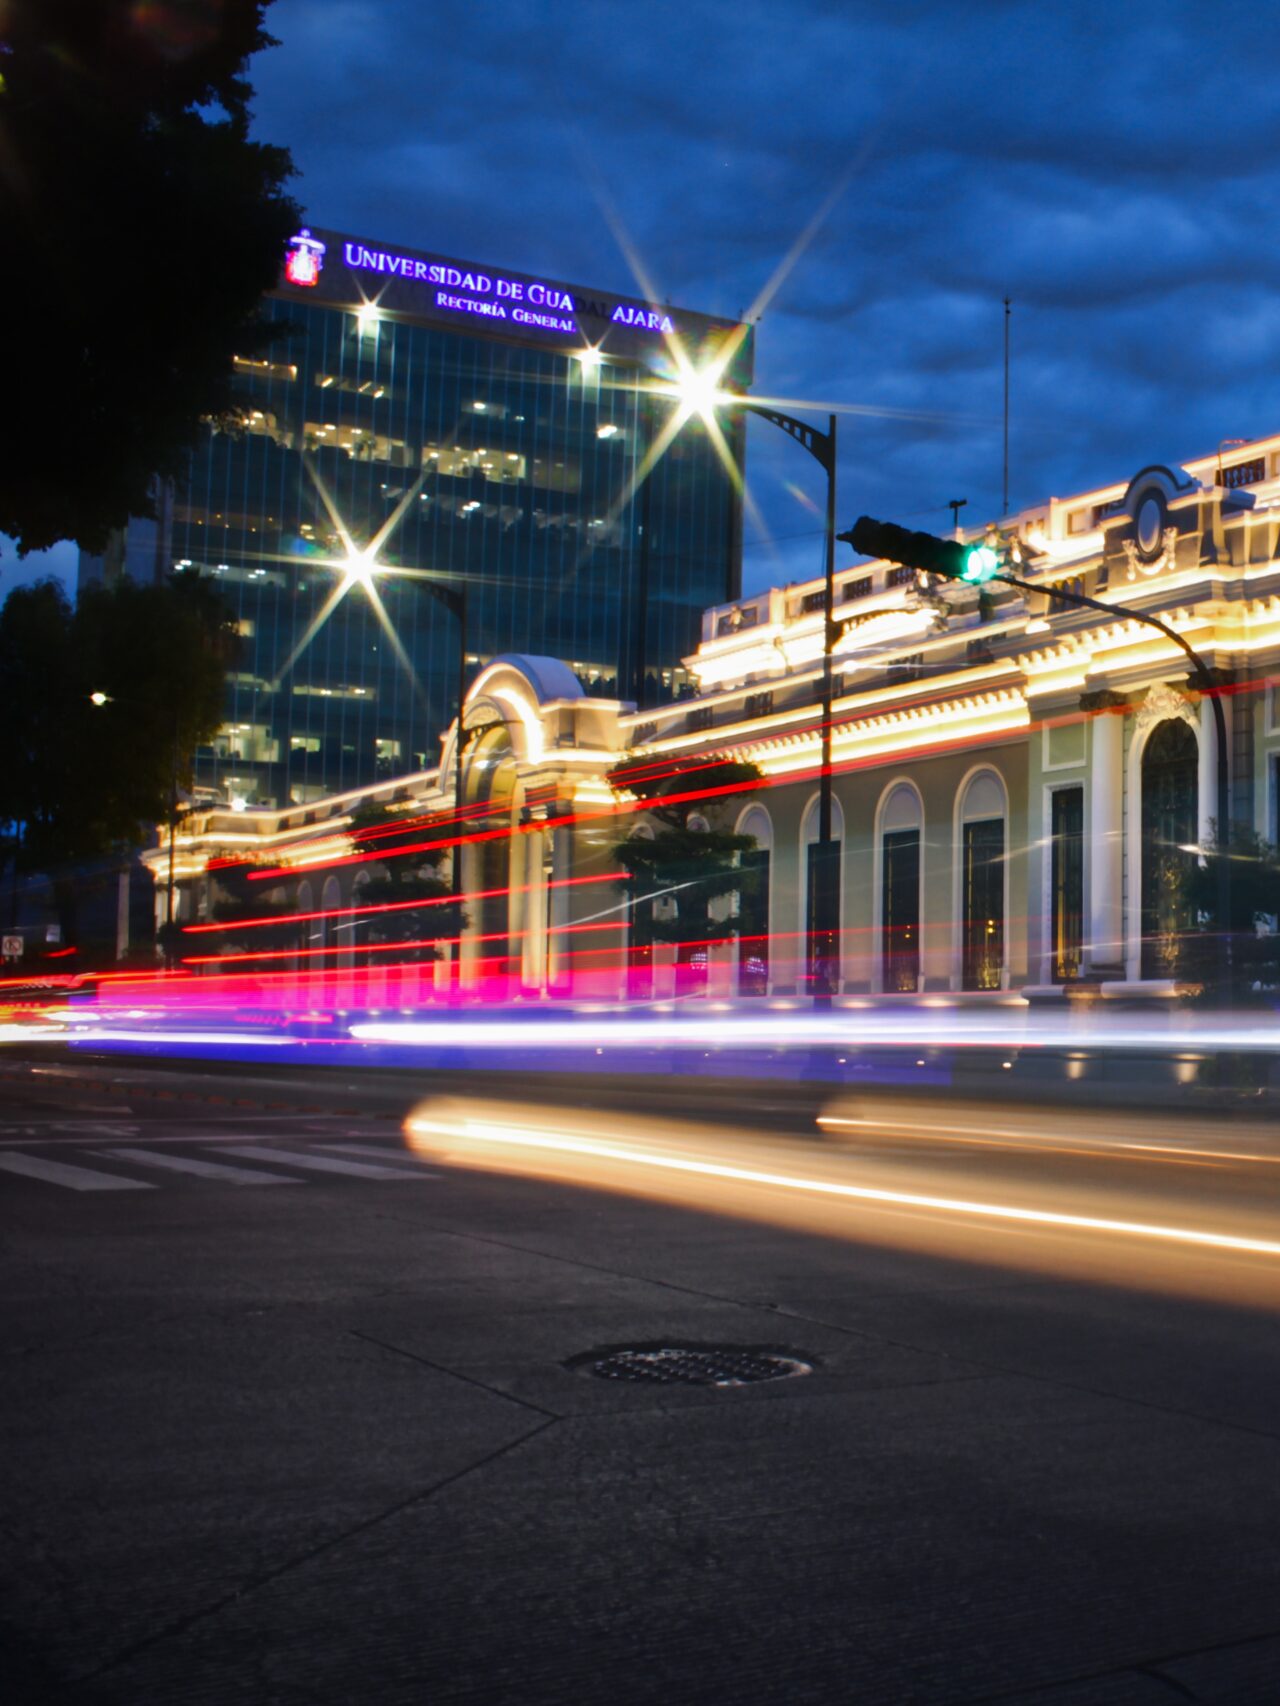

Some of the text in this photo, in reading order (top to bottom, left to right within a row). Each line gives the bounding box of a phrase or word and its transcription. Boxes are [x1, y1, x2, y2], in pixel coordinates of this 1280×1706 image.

[344, 243, 492, 293] UNIVERSIDAD
[496, 279, 524, 301] DE
[436, 292, 577, 332] RECTORÍA GENERAL
